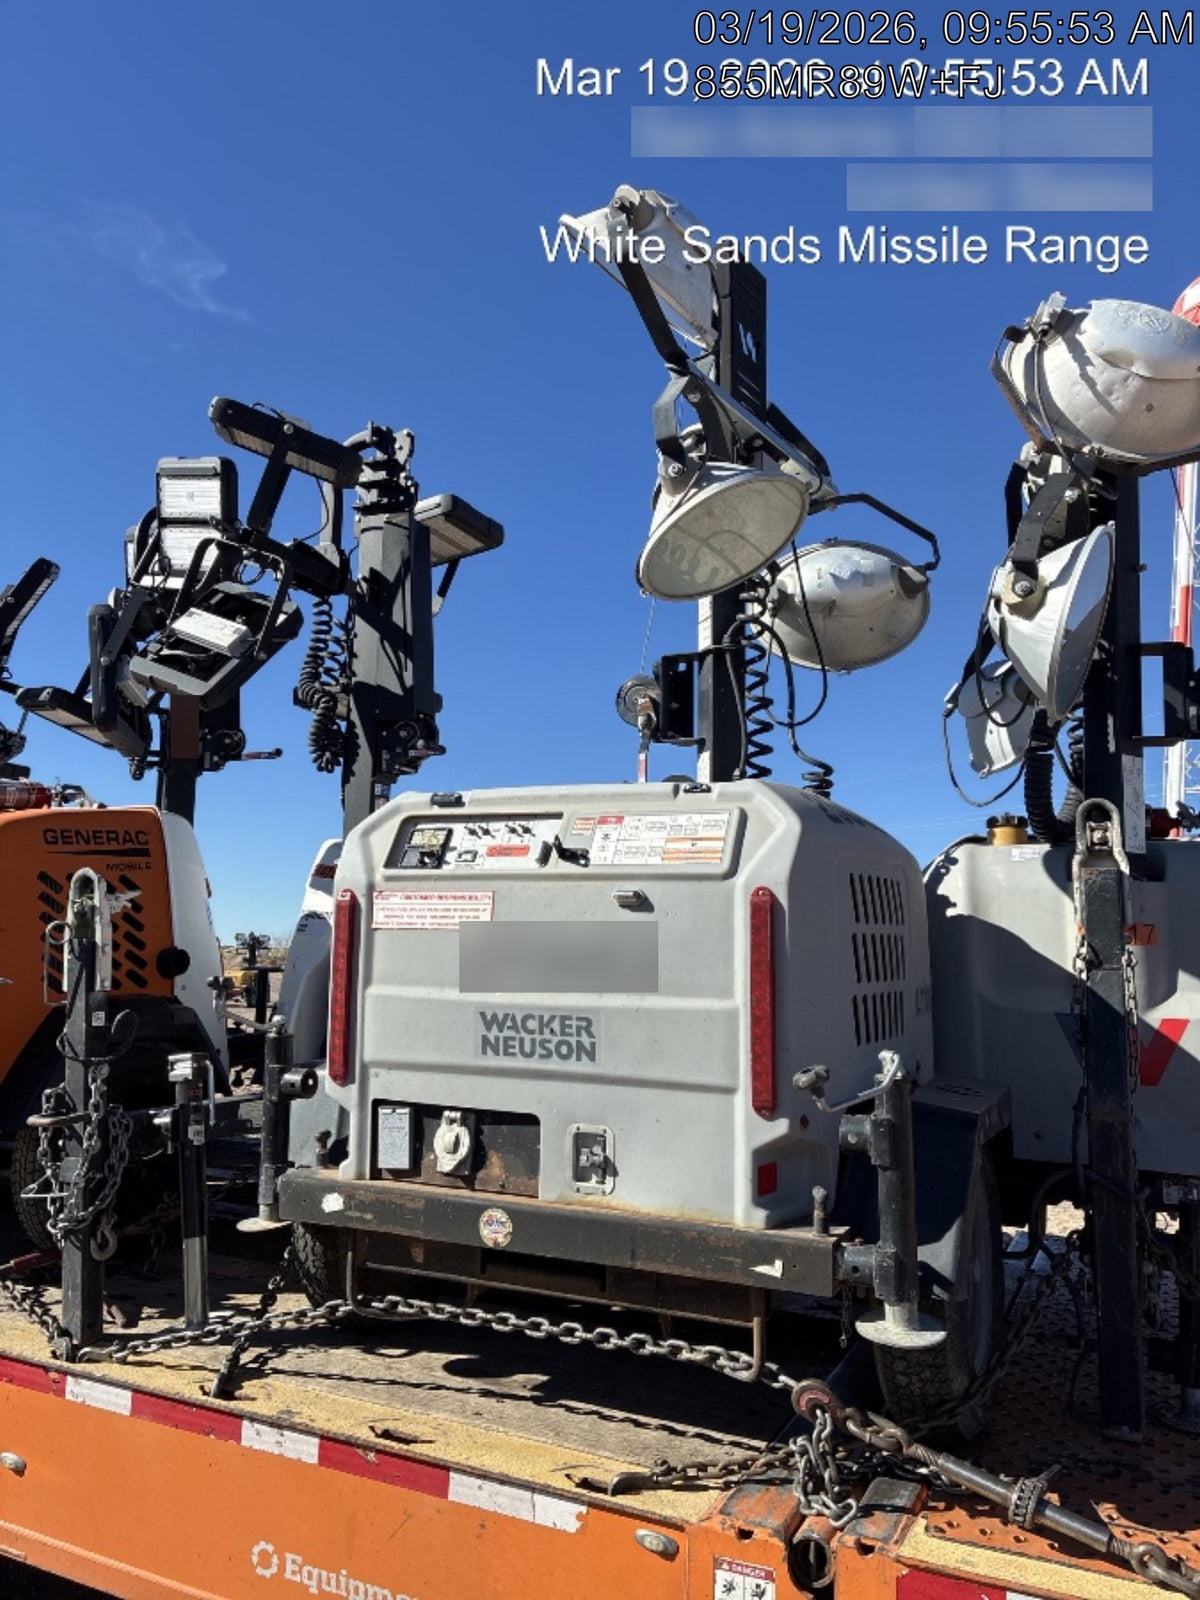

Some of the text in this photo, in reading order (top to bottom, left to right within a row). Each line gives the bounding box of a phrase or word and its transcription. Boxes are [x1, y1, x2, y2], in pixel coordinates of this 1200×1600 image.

[43, 829, 149, 846] GENERAC
[106, 863, 152, 872] MOBILE
[479, 1010, 596, 1040] WACKER
[481, 1035, 597, 1063] NEUSON
